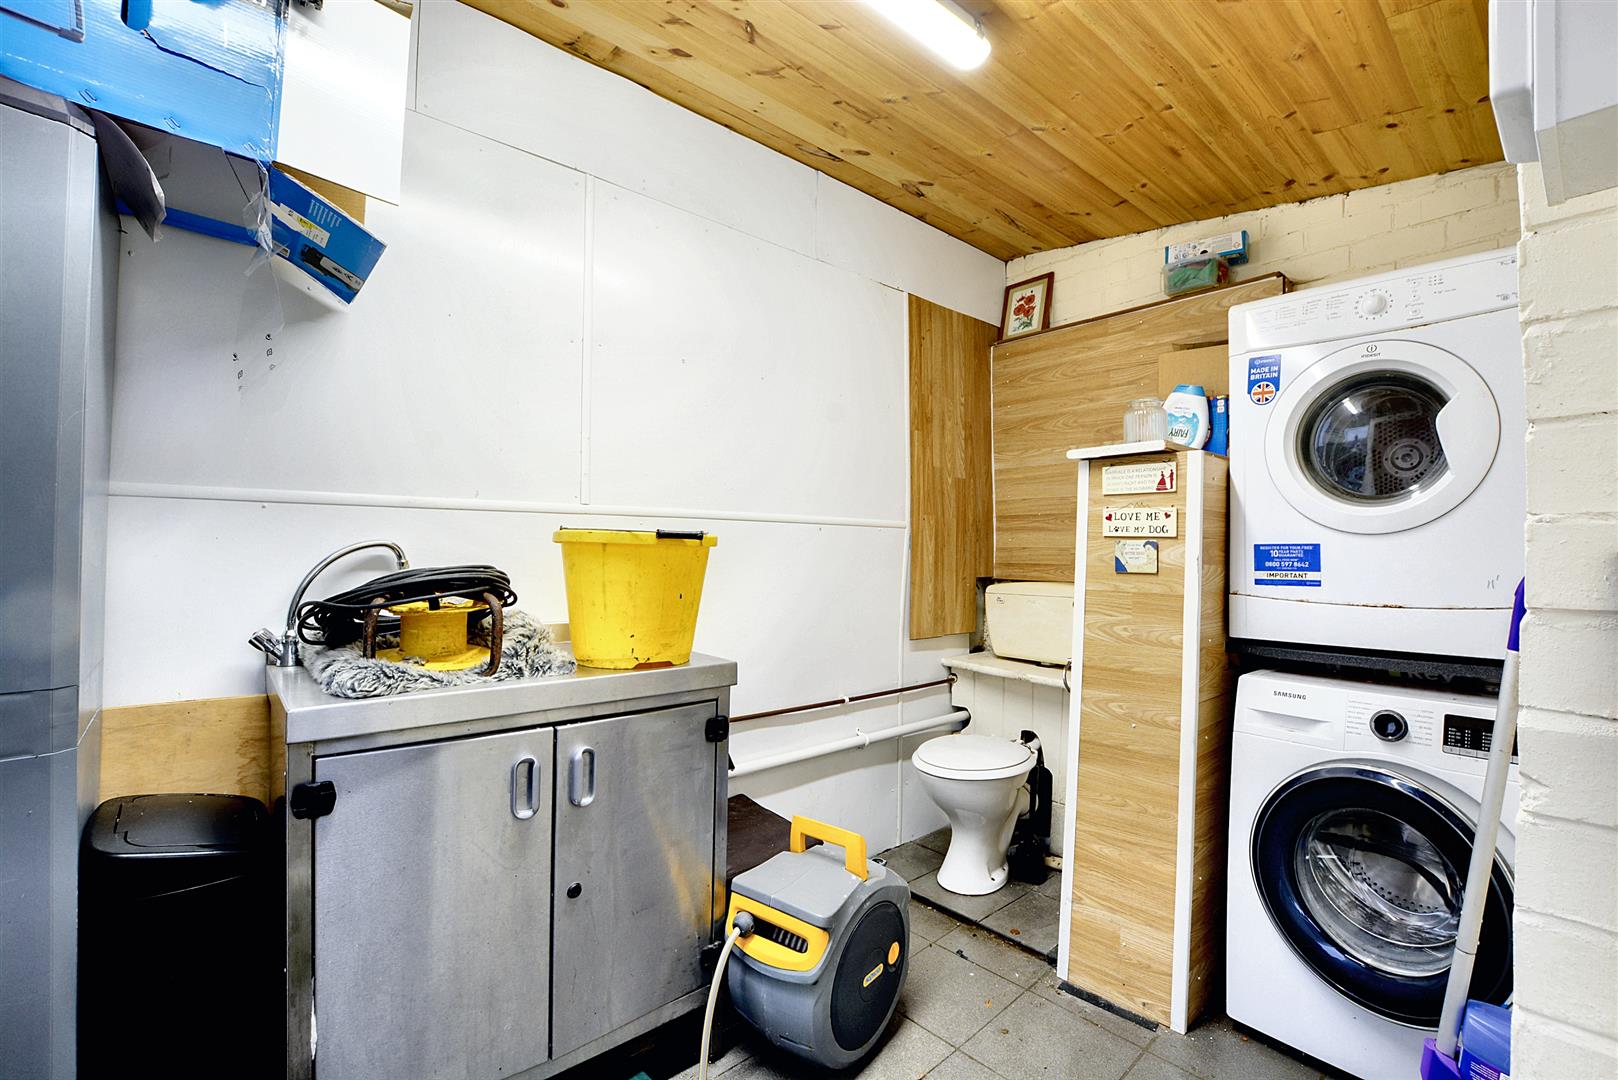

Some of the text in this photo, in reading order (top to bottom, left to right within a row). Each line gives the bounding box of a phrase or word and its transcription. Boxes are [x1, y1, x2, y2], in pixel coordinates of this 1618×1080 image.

[1250, 366, 1270, 374] MADE
[1250, 372, 1279, 380] BRITAIN
[1168, 427, 1189, 438] FAIRY
[1114, 512, 1161, 521] LOVE ME
[1108, 525, 1130, 533] LVE
[1148, 525, 1169, 534] DOG
[1273, 690, 1307, 700] SAMSUNG
